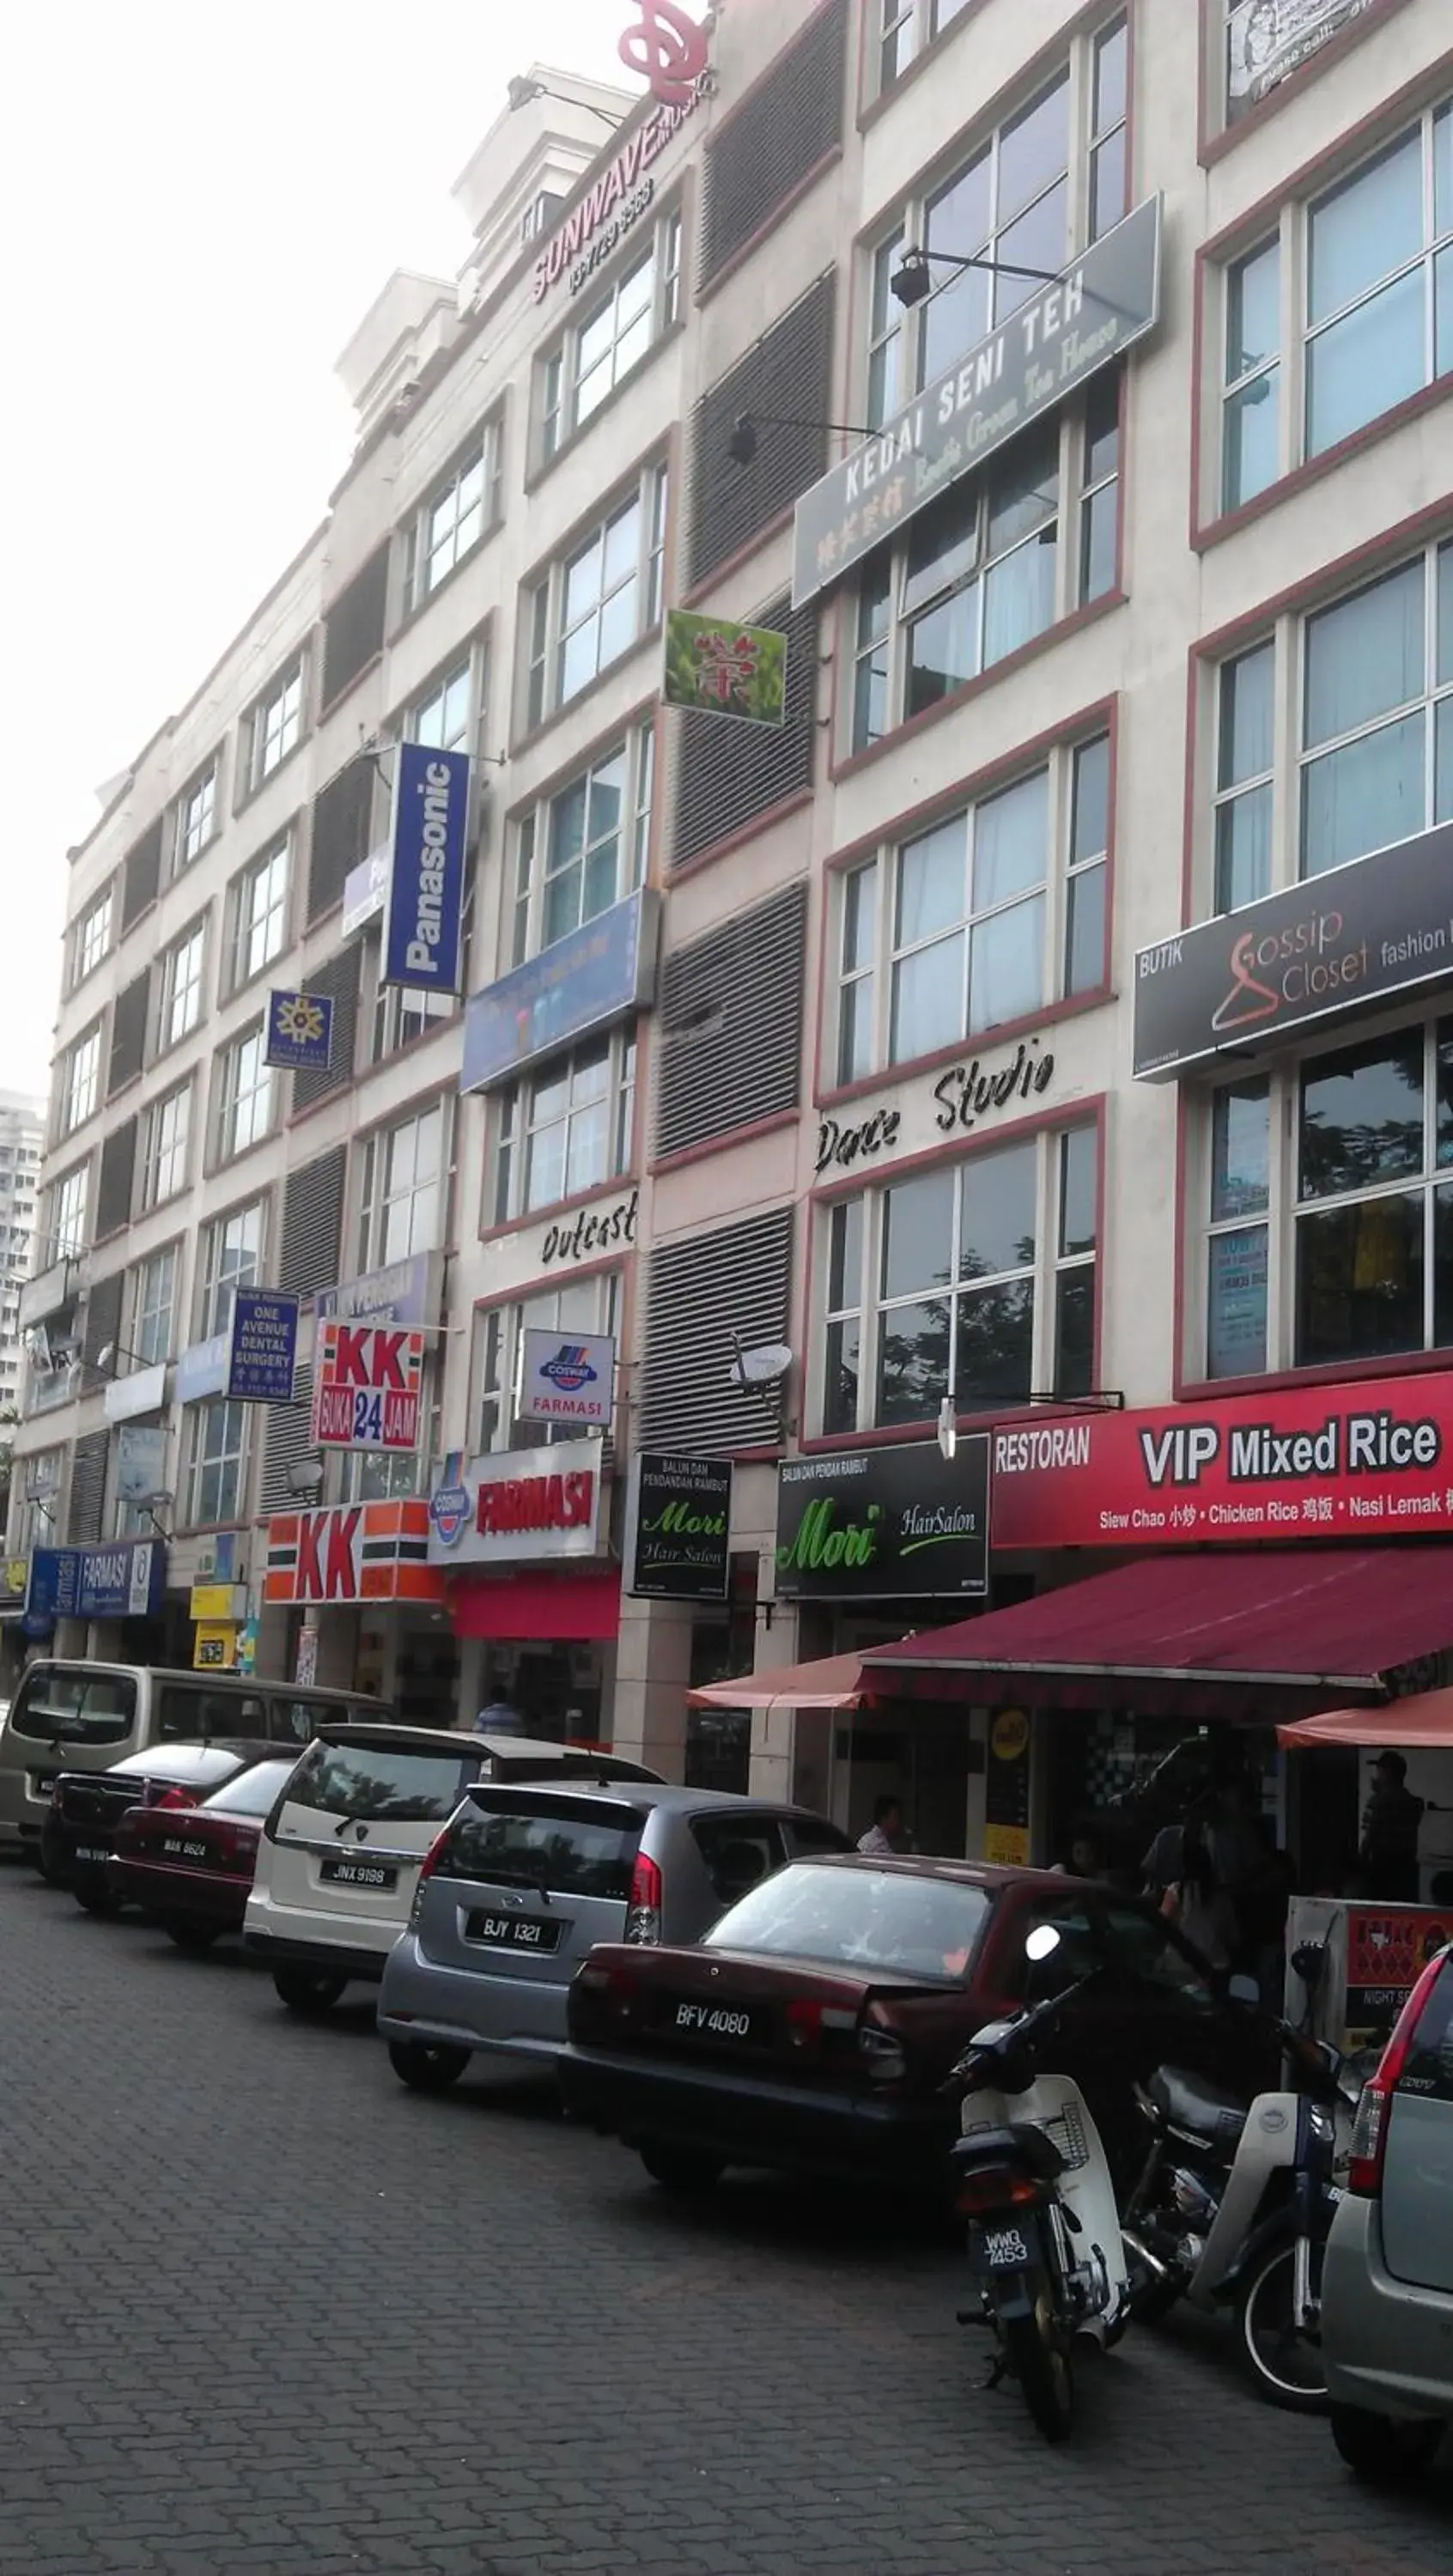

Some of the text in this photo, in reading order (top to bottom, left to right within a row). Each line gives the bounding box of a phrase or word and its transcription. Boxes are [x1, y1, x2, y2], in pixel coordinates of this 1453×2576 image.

[845, 410, 923, 504] KEDAI
[938, 338, 1005, 424] SENI
[1023, 270, 1084, 356] TEH
[406, 762, 452, 973] Panasonic
[1140, 941, 1184, 978] BUTIK
[1282, 939, 1369, 1002] Closet
[1381, 928, 1445, 969] fashion
[814, 1037, 1055, 1173] Dance Studio
[241, 1320, 289, 1336] AVENUE
[254, 1306, 279, 1320] ONE
[235, 1352, 290, 1367] SURGERY
[241, 1336, 287, 1352] DENTAL
[336, 1326, 409, 1388] KK
[320, 1391, 415, 1441] BUKA 24 JAM
[533, 1397, 602, 1415] FARMASI
[995, 1416, 1438, 1483] RESTORAN VIP Mixed Rice
[477, 1470, 593, 1536] FARMASI
[642, 1501, 726, 1535] Mori
[1099, 1510, 1129, 1529] Siew
[1132, 1509, 1165, 1527] Chao
[1209, 1503, 1264, 1524] Chicken
[1267, 1501, 1299, 1522] Rice
[1349, 1494, 1383, 1517] Nasi
[1388, 1492, 1442, 1516] Lemak
[776, 1497, 882, 1570] Mori
[84, 1552, 127, 1589] FARMASI
[295, 1507, 362, 1600] KK
[642, 1543, 721, 1563] Hair Salon
[333, 1865, 356, 1881] JNX
[483, 1917, 542, 1942] BJY 1321
[1364, 1990, 1395, 2006] NIGHT
[676, 2003, 750, 2036] BFV 4080
[984, 2244, 1028, 2267] 7453
[985, 2229, 1020, 2249] WWQ
